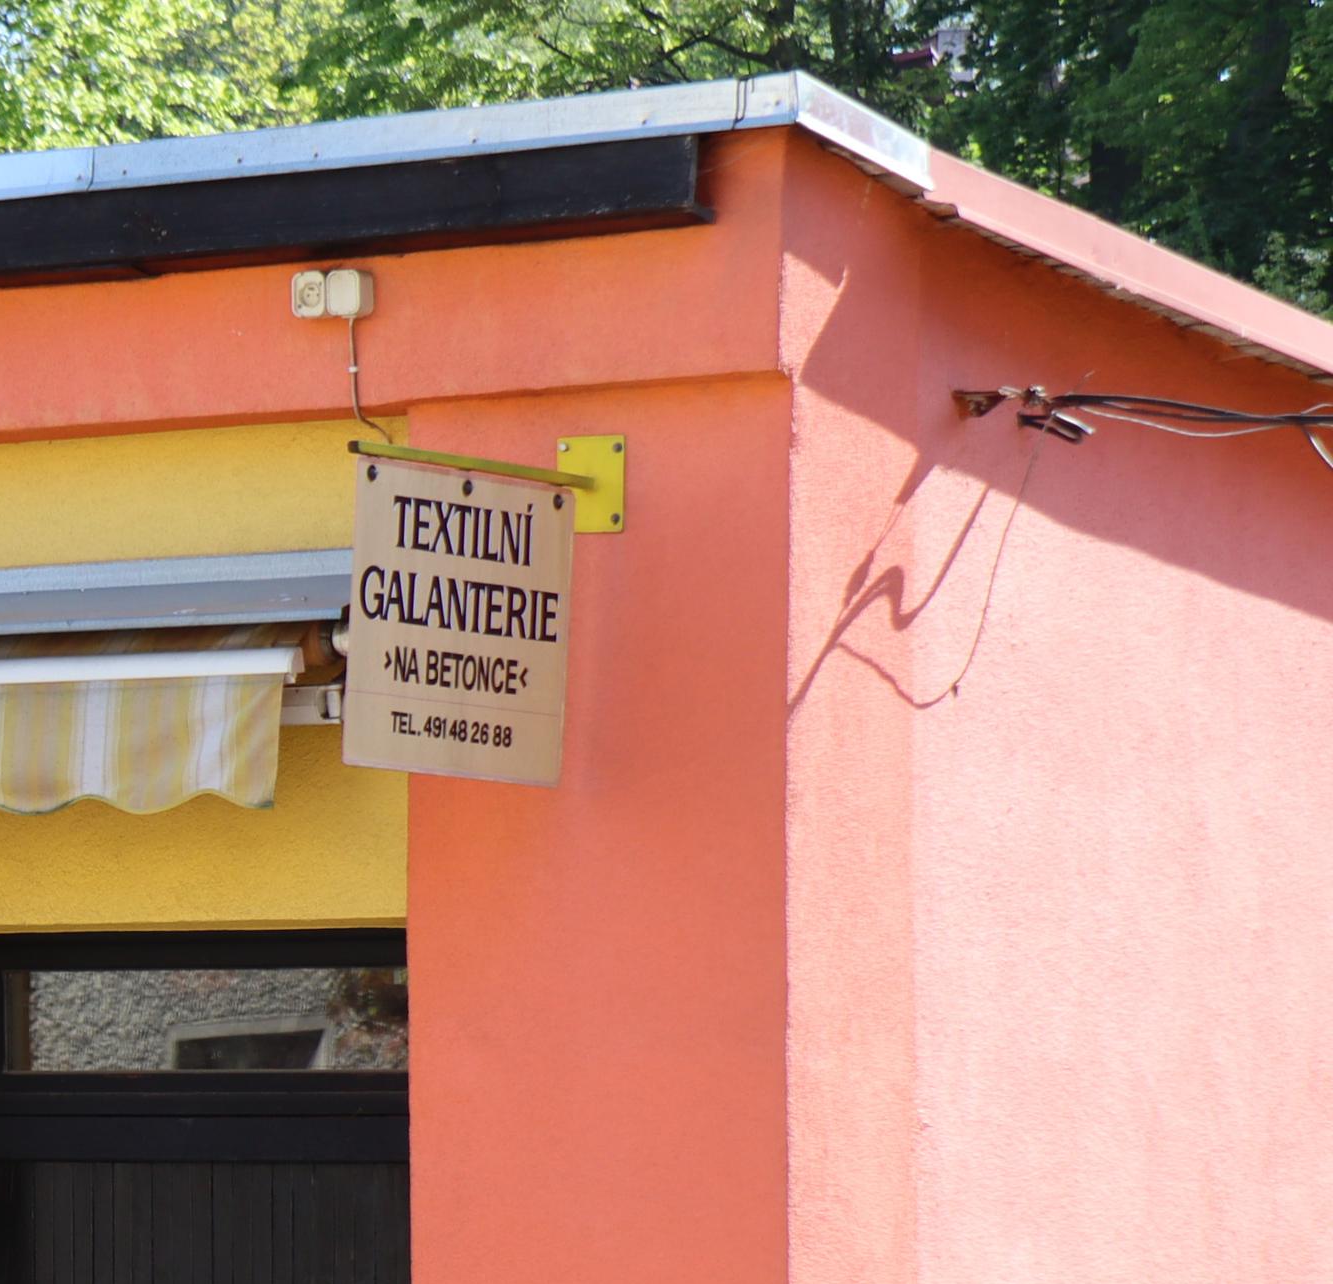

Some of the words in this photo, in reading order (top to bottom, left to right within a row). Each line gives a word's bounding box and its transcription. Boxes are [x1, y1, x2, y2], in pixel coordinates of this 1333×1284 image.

[393, 495, 533, 567] TEXTILNÍ
[360, 565, 559, 642] GALANTERIE
[391, 711, 421, 737] TEL.
[423, 716, 447, 739] 491
[448, 720, 468, 742] 48
[471, 722, 489, 745] 26
[493, 726, 513, 748] 88
